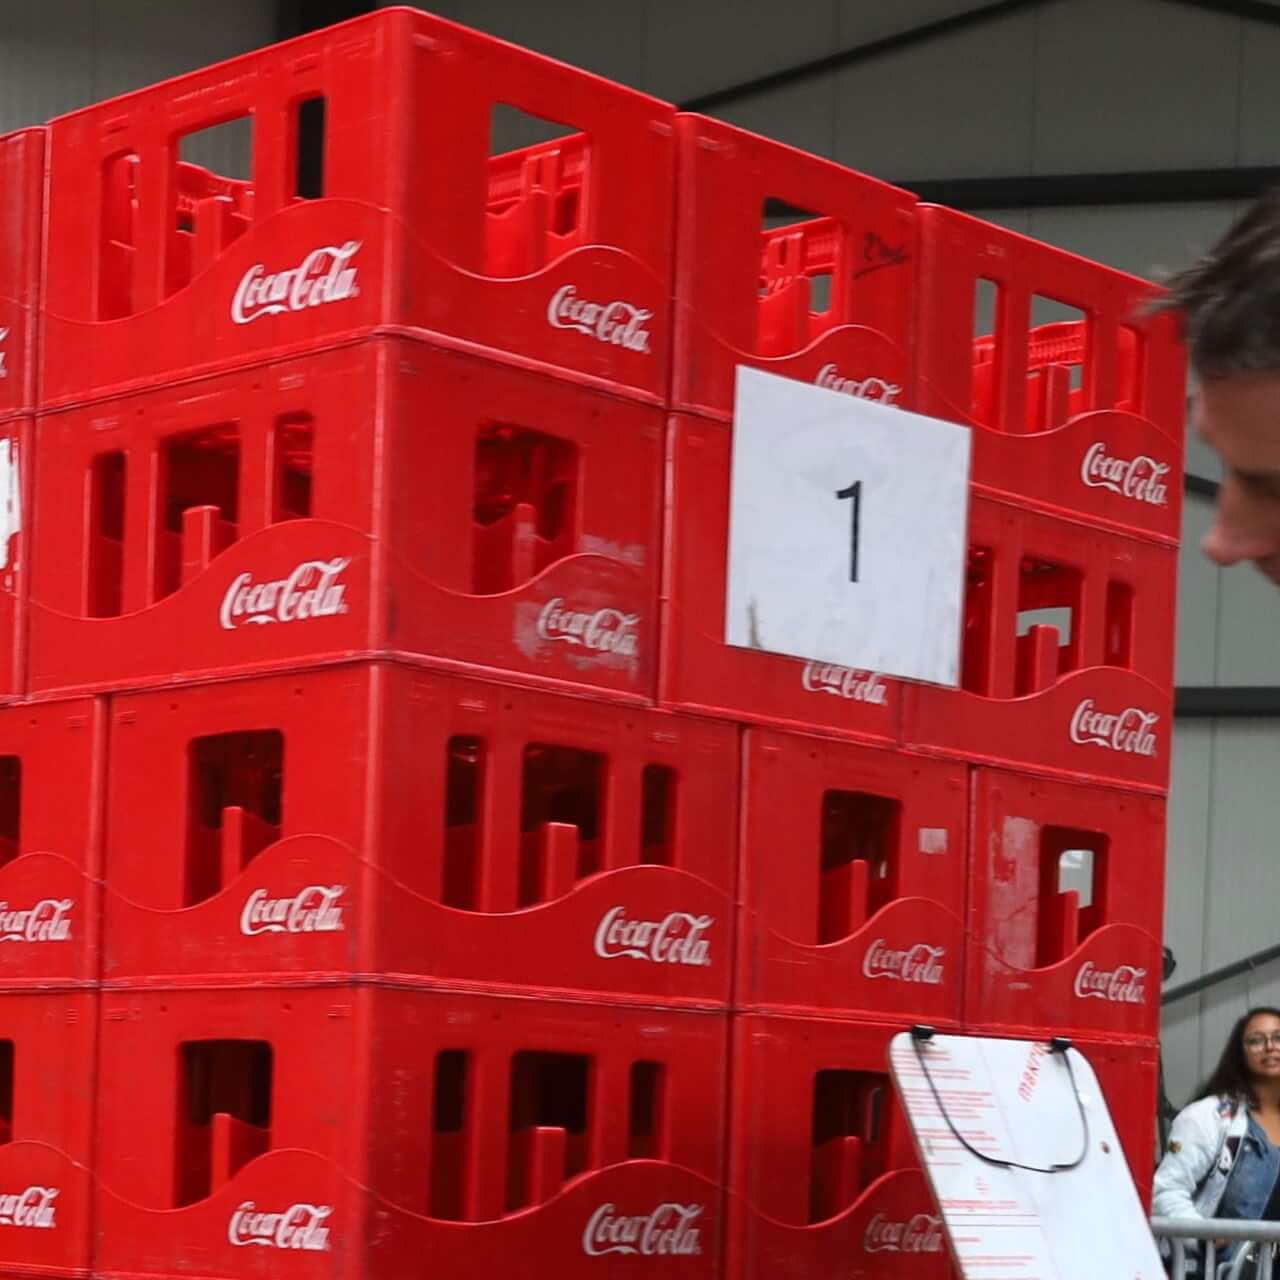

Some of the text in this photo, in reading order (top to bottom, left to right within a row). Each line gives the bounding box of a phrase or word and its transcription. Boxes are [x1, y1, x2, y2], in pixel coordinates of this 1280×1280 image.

[231, 241, 361, 324] Coca-Cola
[547, 284, 653, 353] Coca-Cola
[1081, 442, 1170, 505] Coca-Cola
[836, 480, 862, 583] 1
[220, 557, 350, 629] Coca-Cola
[1070, 699, 1159, 756] Coca-Cola
[240, 885, 344, 936] Coca-Cola
[594, 906, 713, 965] Coca-Cola
[862, 938, 945, 985] Coca-Cola
[1074, 961, 1147, 1003] Coca-Cola
[228, 1201, 332, 1251] Coca-Cola
[583, 1203, 701, 1256] Coca-Cola
